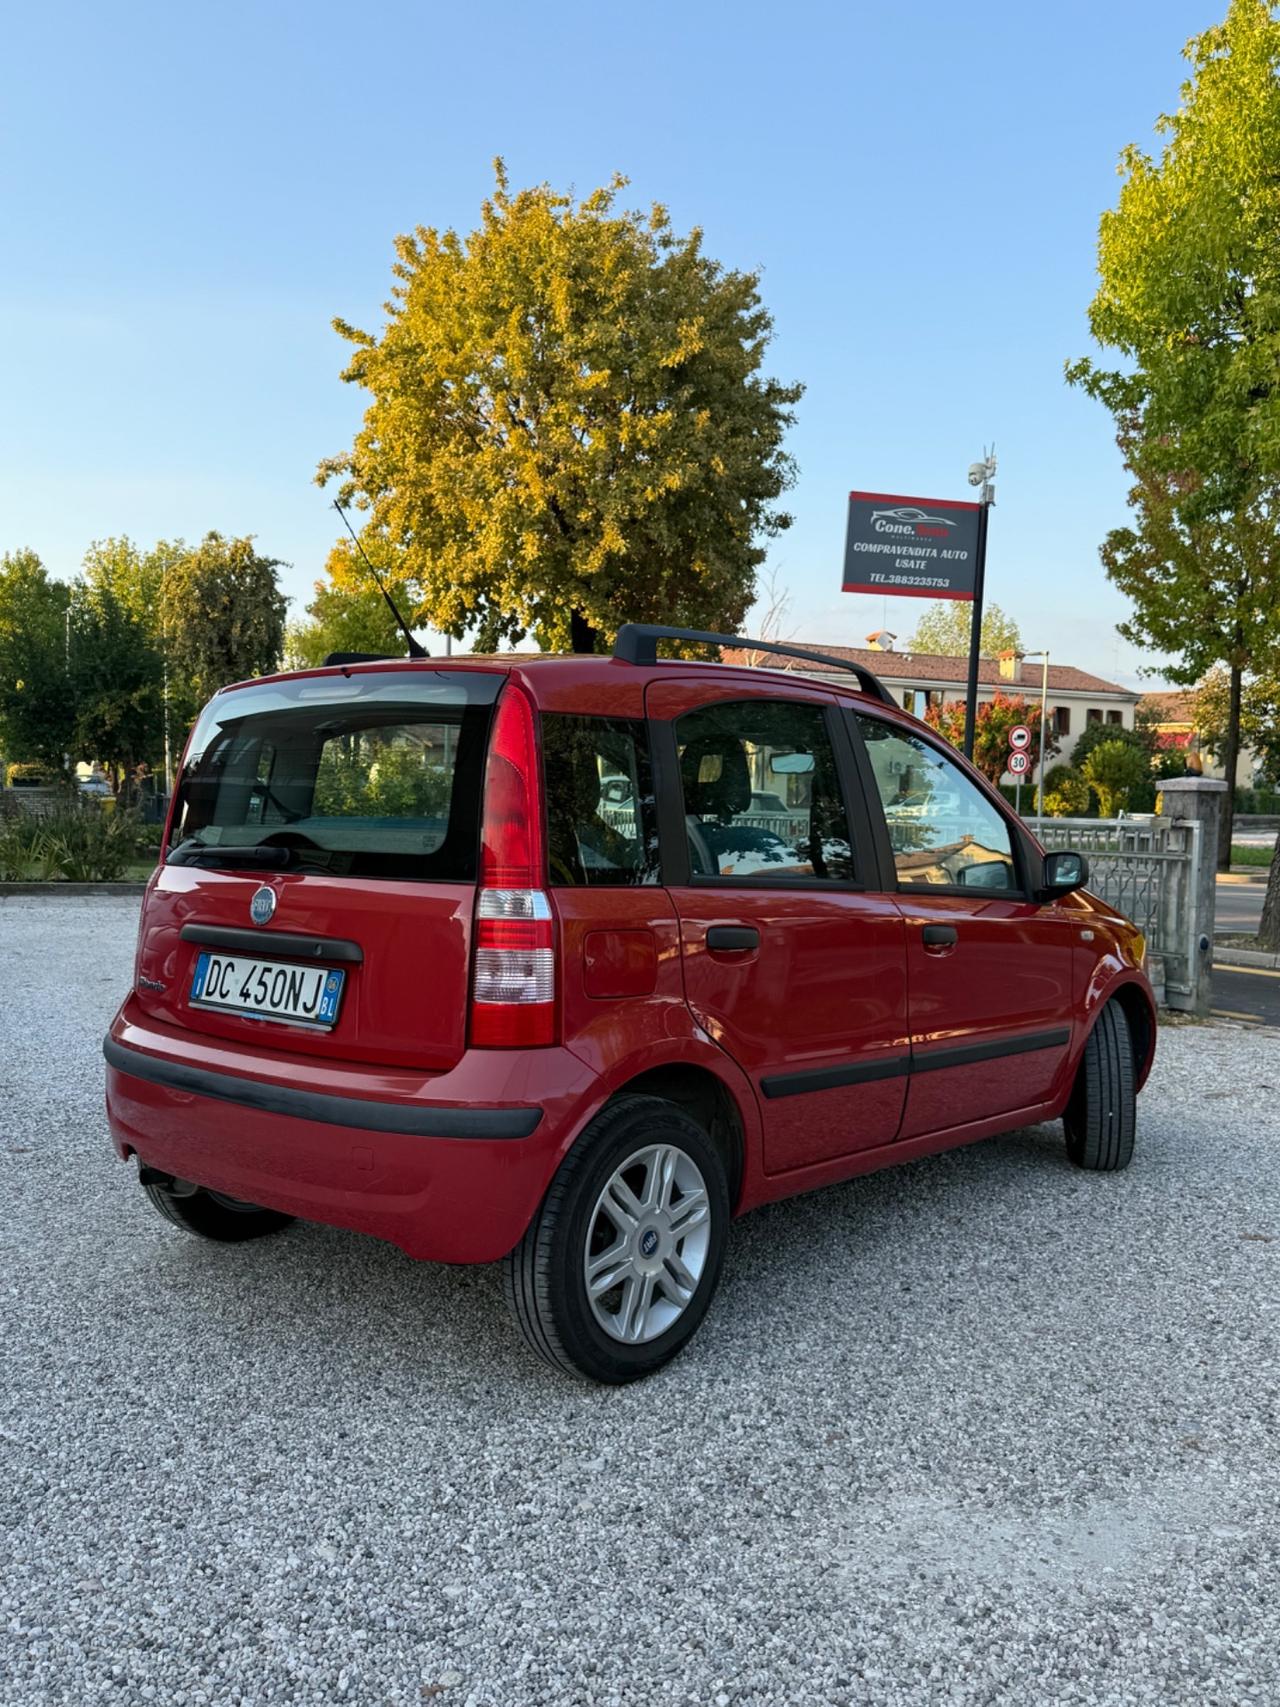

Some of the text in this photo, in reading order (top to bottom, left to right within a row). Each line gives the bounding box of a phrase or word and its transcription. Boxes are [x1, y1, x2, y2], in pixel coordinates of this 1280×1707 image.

[853, 542, 968, 561] COMPRAVENDITA AUTO
[895, 558, 928, 570] USATE
[1013, 757, 1024, 768] 30
[205, 959, 323, 1014] DC 450NJ
[321, 997, 333, 1016] BL
